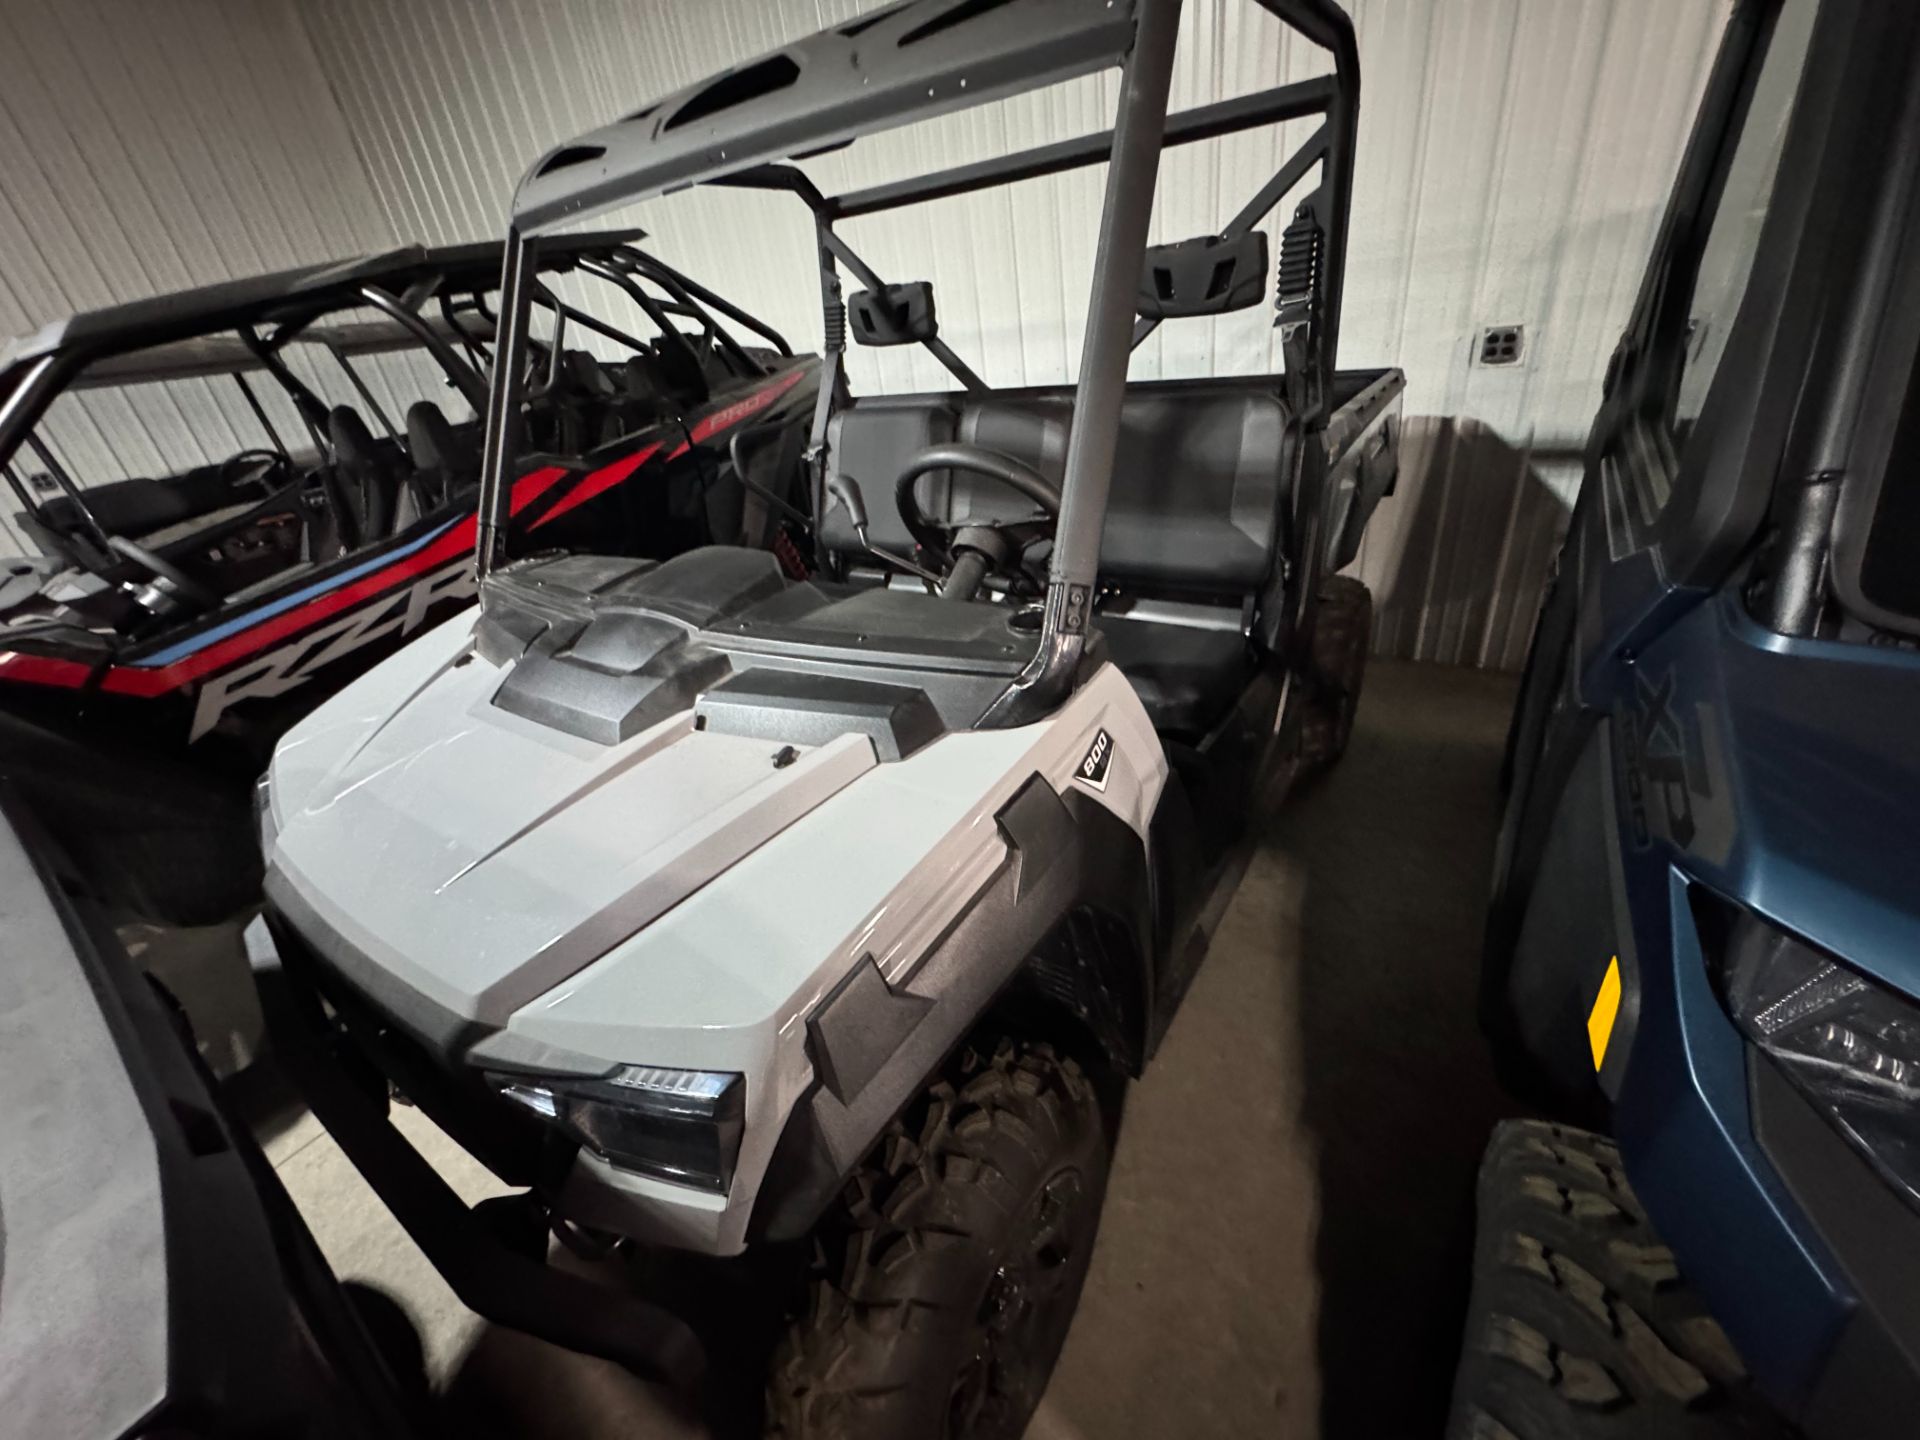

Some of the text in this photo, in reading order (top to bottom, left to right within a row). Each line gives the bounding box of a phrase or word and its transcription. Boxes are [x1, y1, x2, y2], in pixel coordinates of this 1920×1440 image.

[188, 556, 479, 745] RZR
[1083, 731, 1108, 777] 800
[1632, 662, 1695, 849] XP
